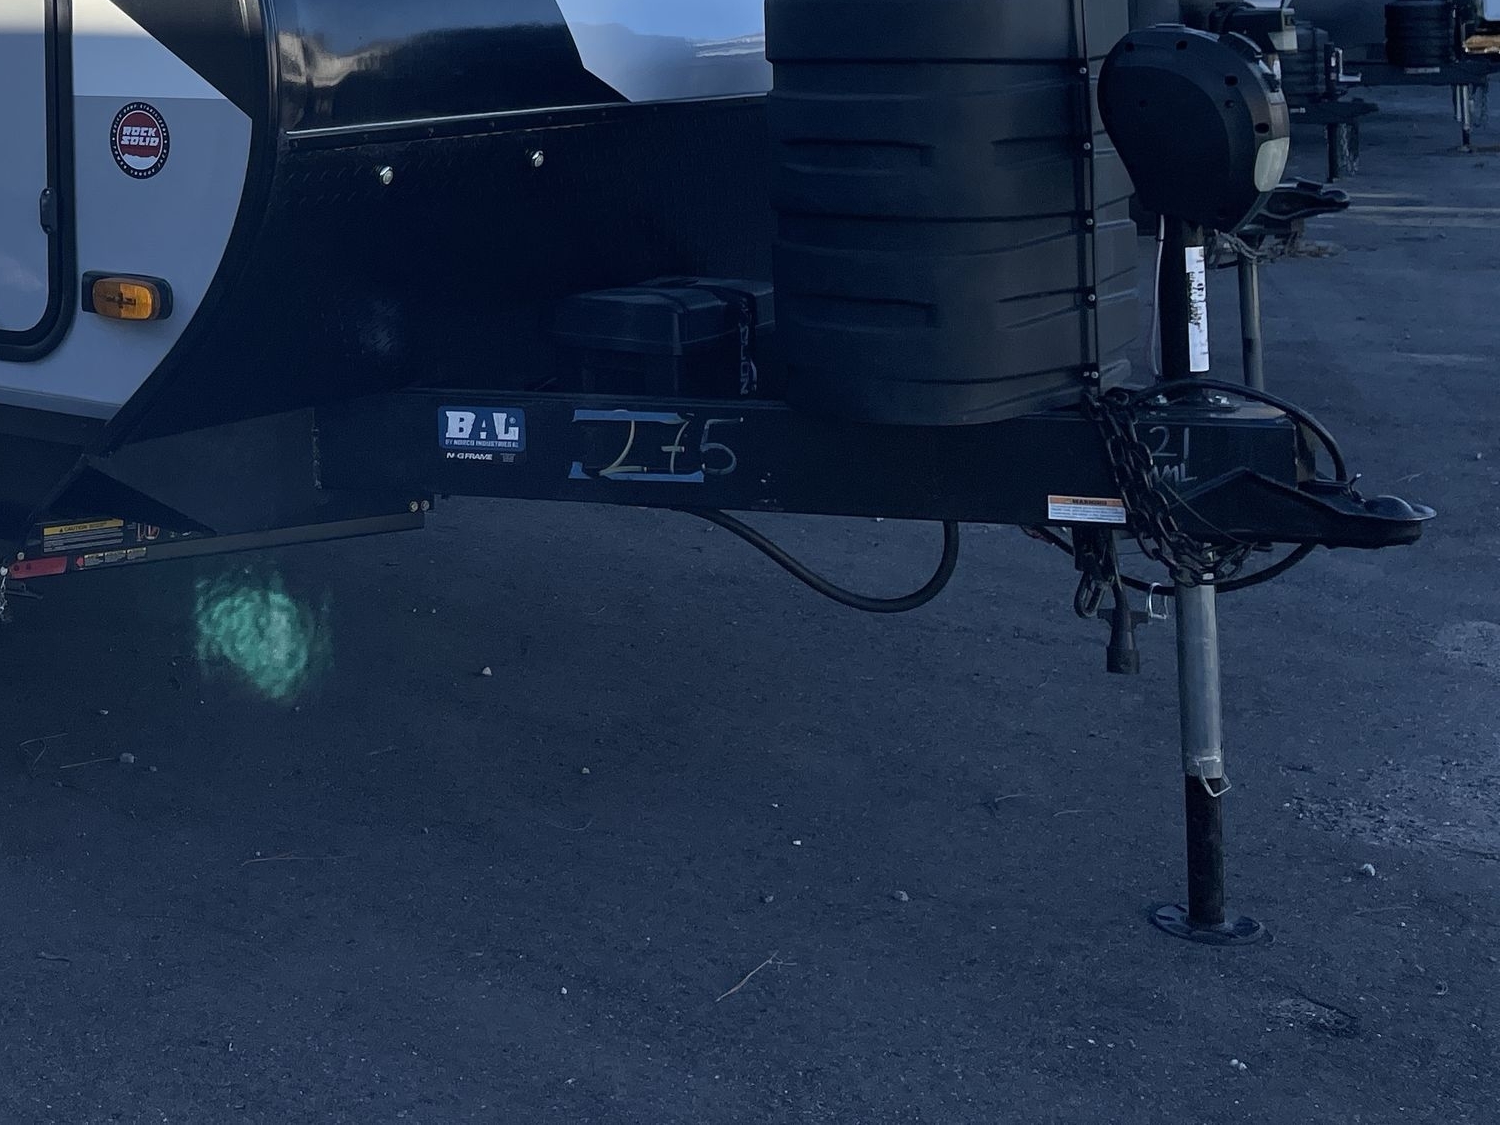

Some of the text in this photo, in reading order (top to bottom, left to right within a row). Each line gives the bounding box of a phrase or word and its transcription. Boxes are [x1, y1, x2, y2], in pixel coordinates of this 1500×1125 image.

[122, 126, 157, 137] ROCK
[120, 135, 160, 147] SOLID
[445, 410, 519, 441] BAL
